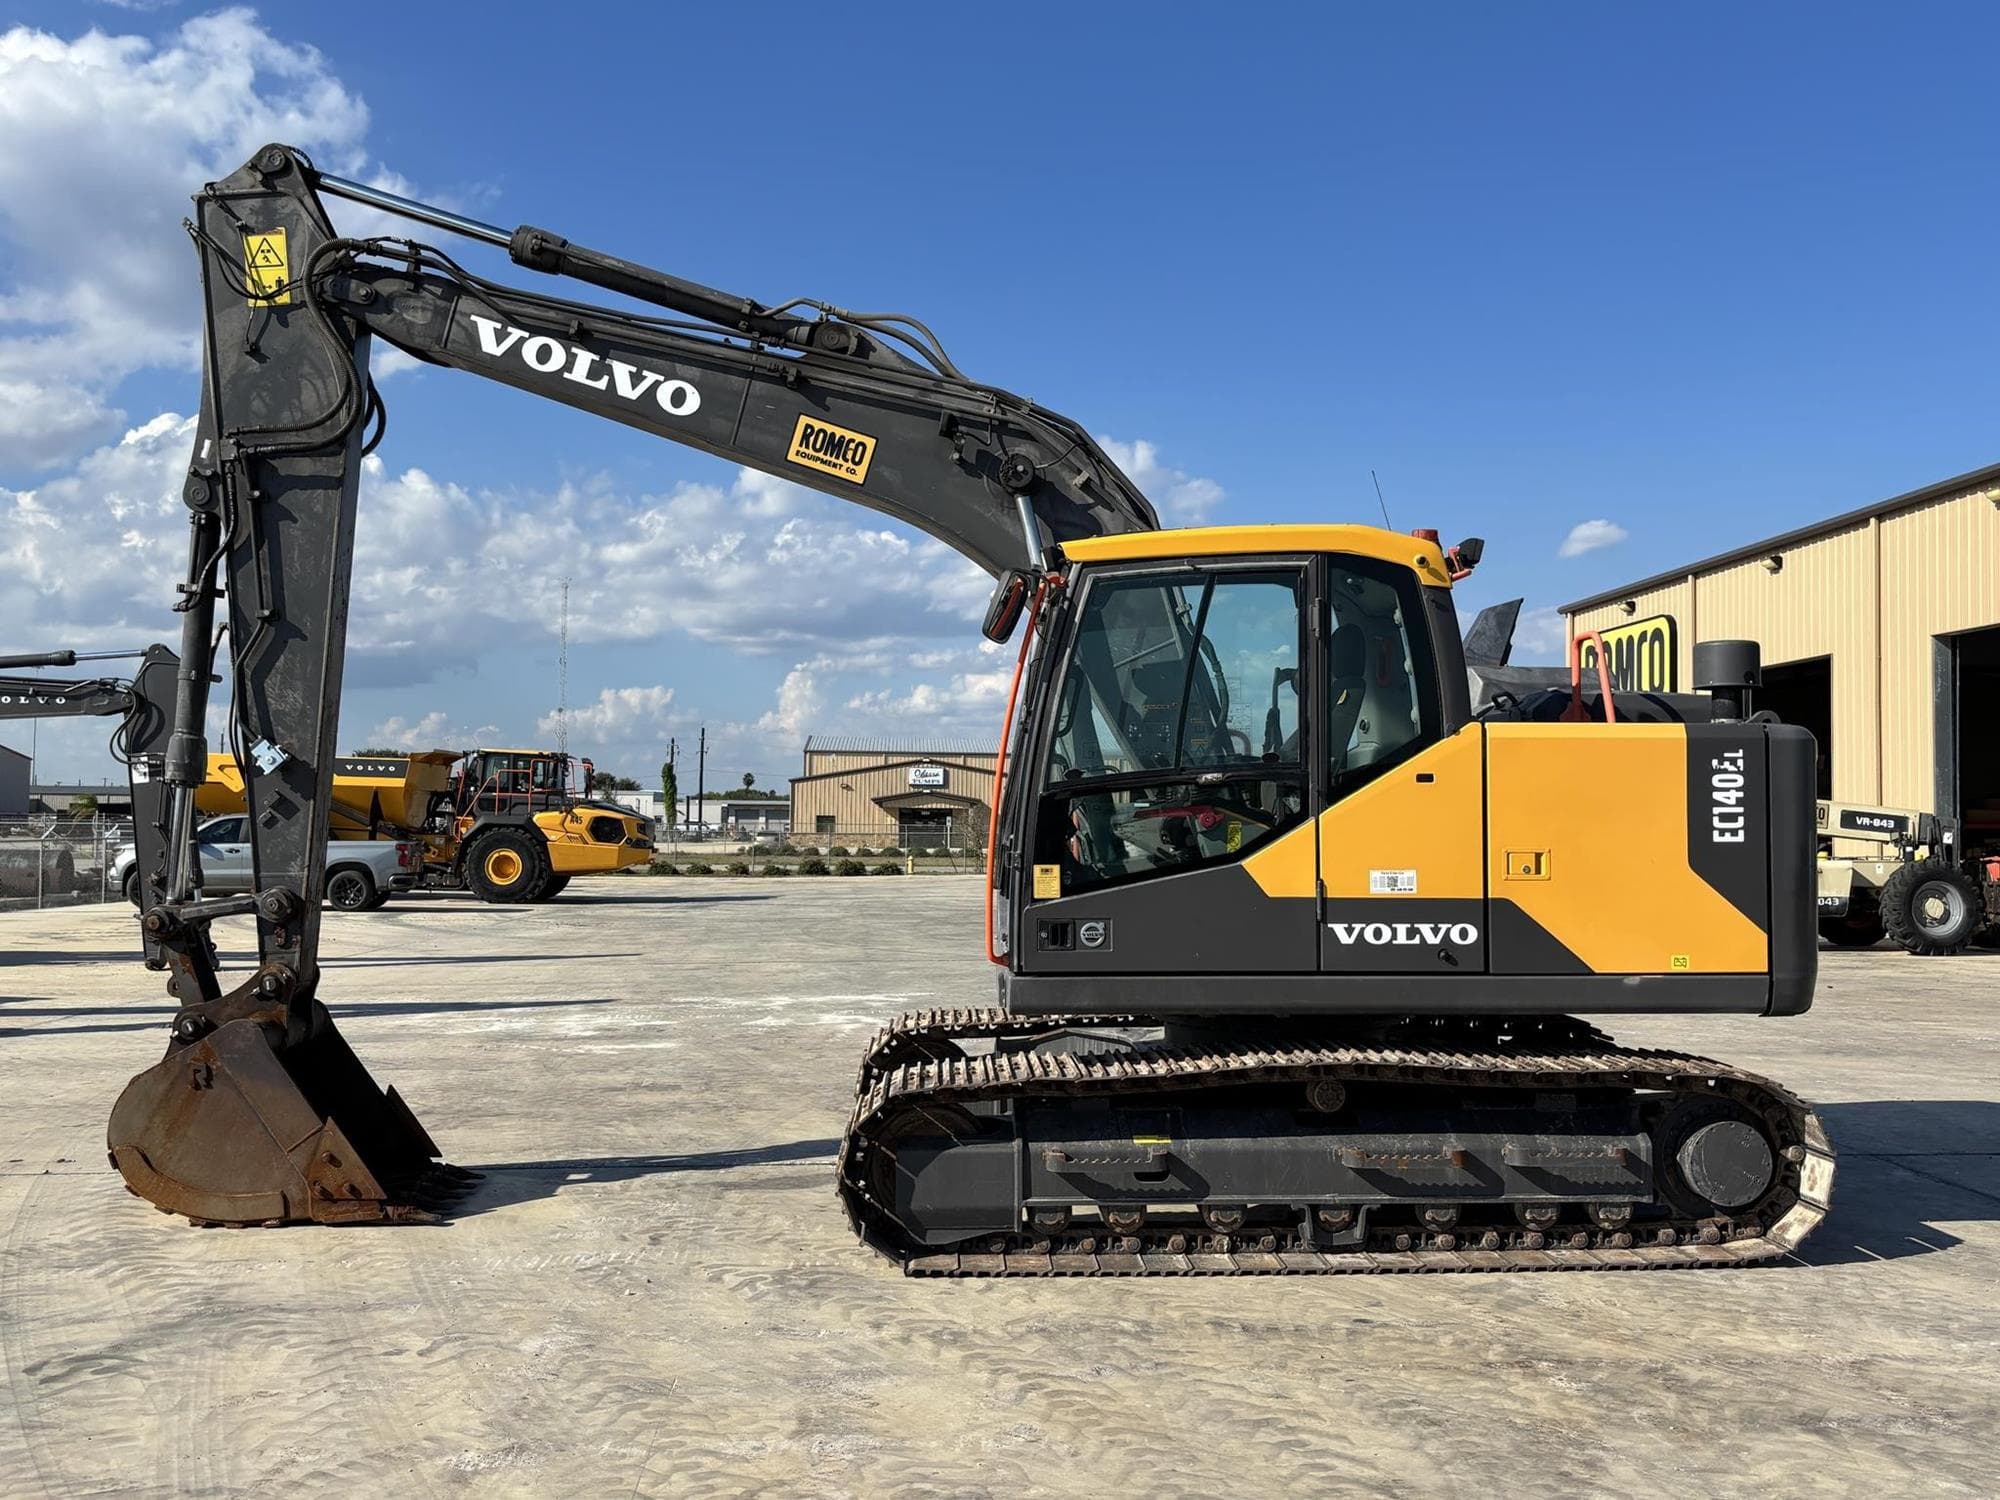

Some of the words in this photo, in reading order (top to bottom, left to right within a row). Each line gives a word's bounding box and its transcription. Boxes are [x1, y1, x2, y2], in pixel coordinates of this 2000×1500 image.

[470, 314, 701, 416] VOLVO
[795, 450, 843, 471] EQUIPMENT
[846, 467, 858, 476] CO.
[0, 696, 66, 704] OLVO
[345, 764, 396, 772] VOLVO
[1855, 816, 1895, 828] VR-843
[1327, 923, 1478, 945] VOLVO
